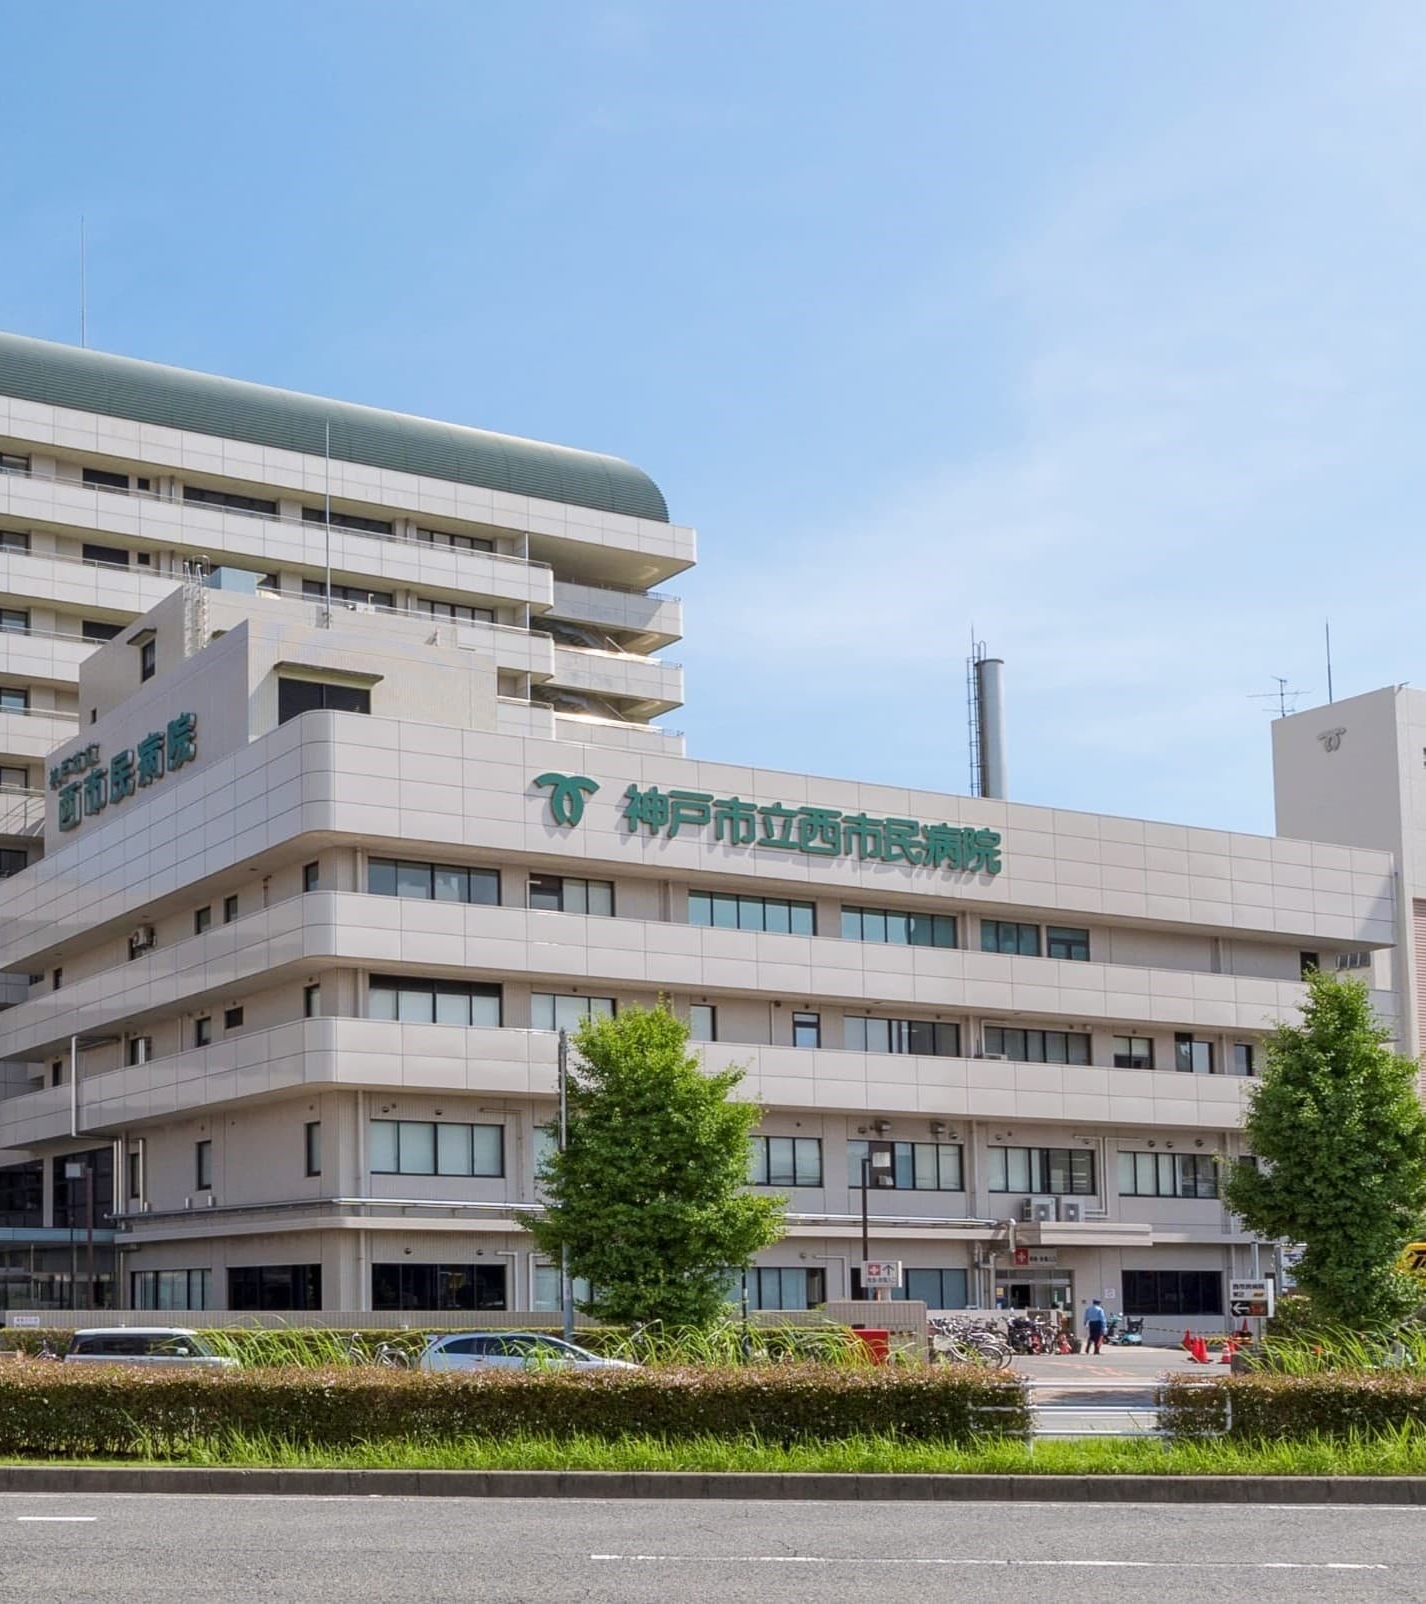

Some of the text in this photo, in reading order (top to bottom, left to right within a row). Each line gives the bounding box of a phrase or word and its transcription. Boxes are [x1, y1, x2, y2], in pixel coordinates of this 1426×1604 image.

[59, 712, 197, 832] 西市民病院
[623, 783, 1002, 875] 神戸市立西市民病院
